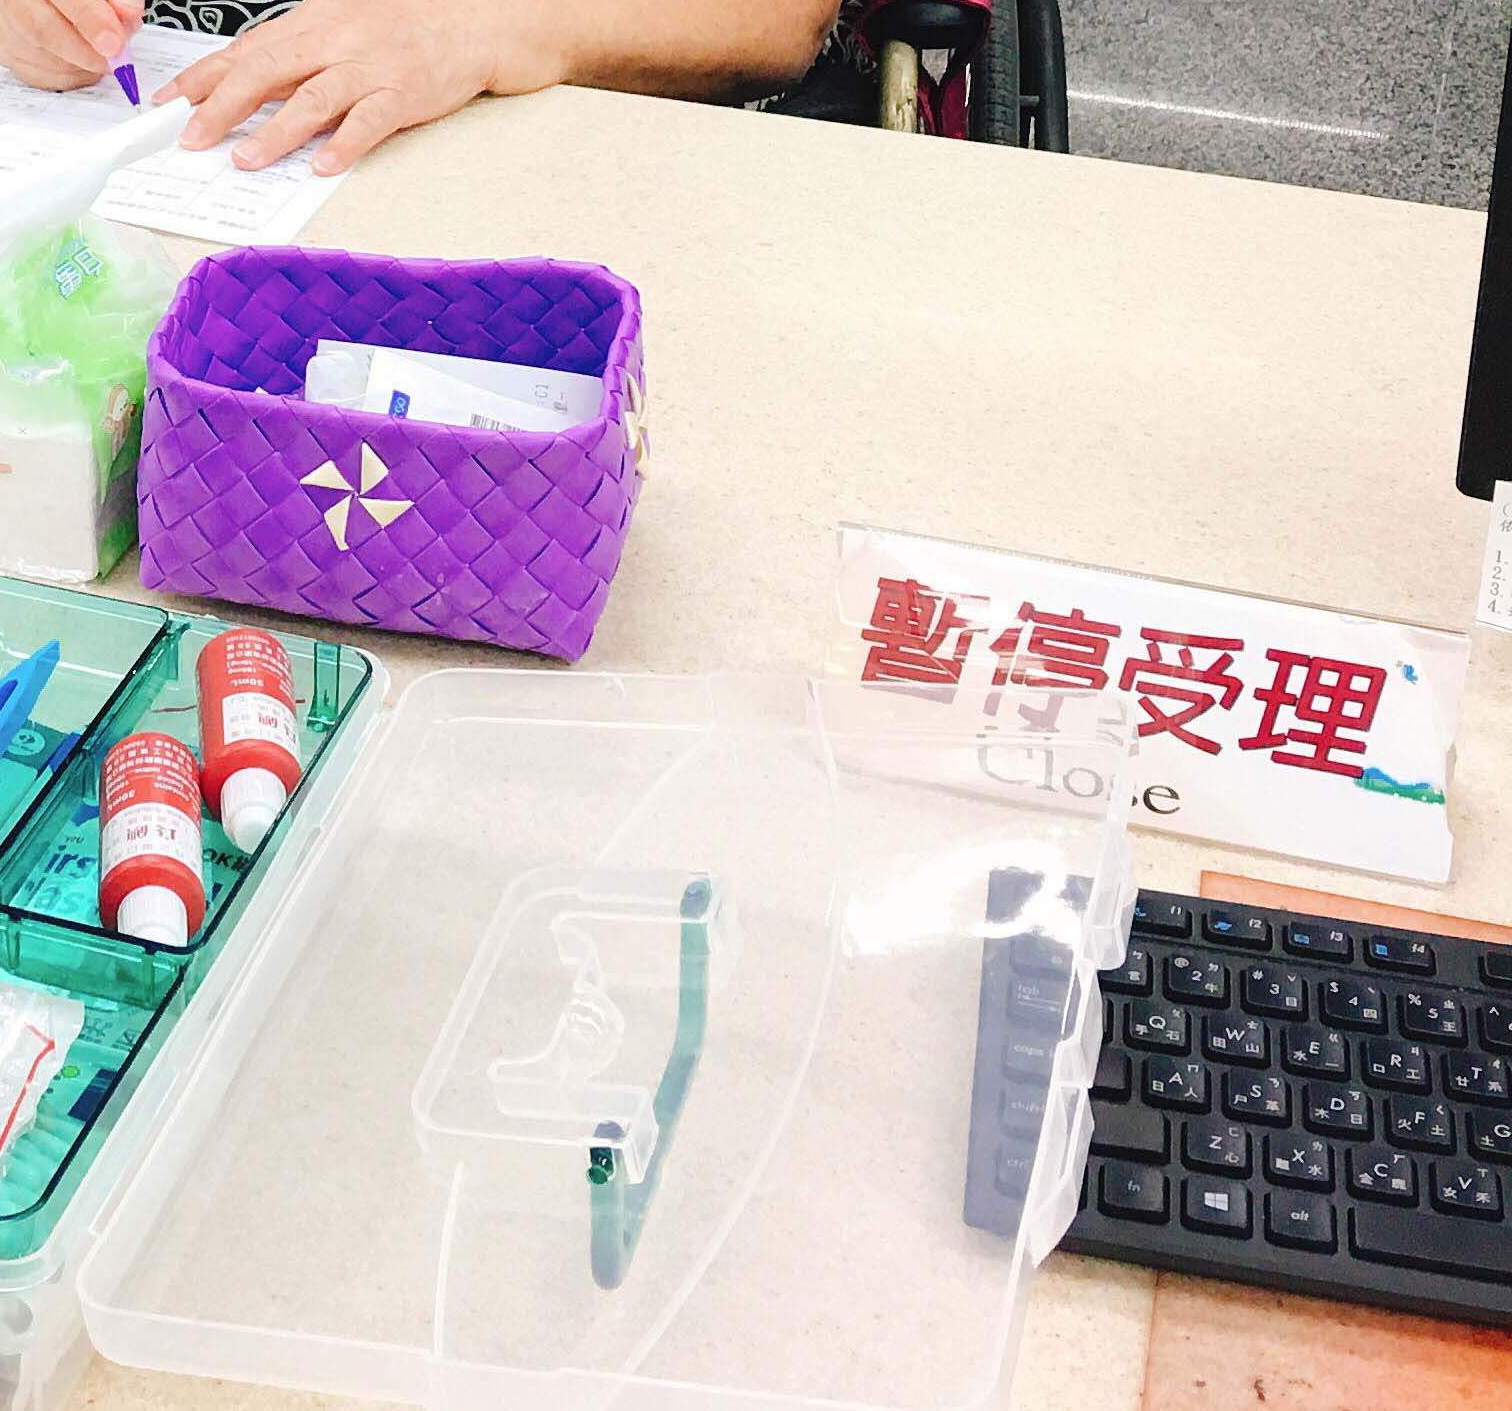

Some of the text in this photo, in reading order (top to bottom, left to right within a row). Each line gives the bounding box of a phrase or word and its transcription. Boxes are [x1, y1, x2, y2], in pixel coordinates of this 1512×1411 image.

[860, 577, 1388, 779] 暫停受理
[977, 741, 1182, 815] Cloe
[1192, 970, 1202, 981] 2
[1252, 971, 1264, 981] #
[1269, 983, 1280, 995] 3
[1348, 996, 1358, 1006] 4
[1408, 993, 1422, 1006] %
[1428, 1008, 1438, 1019] 5
[1148, 1015, 1166, 1031] Q
[1225, 1027, 1246, 1041] W
[1246, 1043, 1260, 1053] 山
[1308, 1041, 1321, 1055] E
[1390, 1053, 1402, 1067] R
[1168, 1071, 1184, 1085] A
[1406, 1067, 1421, 1080] 工
[1470, 1066, 1483, 1079] T
[1184, 1087, 1198, 1099] 人
[1250, 1084, 1262, 1097] S
[1330, 1097, 1345, 1111] D
[1414, 1111, 1426, 1124] F
[1430, 1125, 1446, 1137] 土
[1494, 1123, 1512, 1138] G
[1208, 1135, 1223, 1150] Z
[1292, 1149, 1305, 1164] X
[1373, 1163, 1388, 1177] C
[1127, 1179, 1141, 1192] fn
[1458, 1176, 1473, 1190] V
[1290, 1210, 1310, 1223] alt
